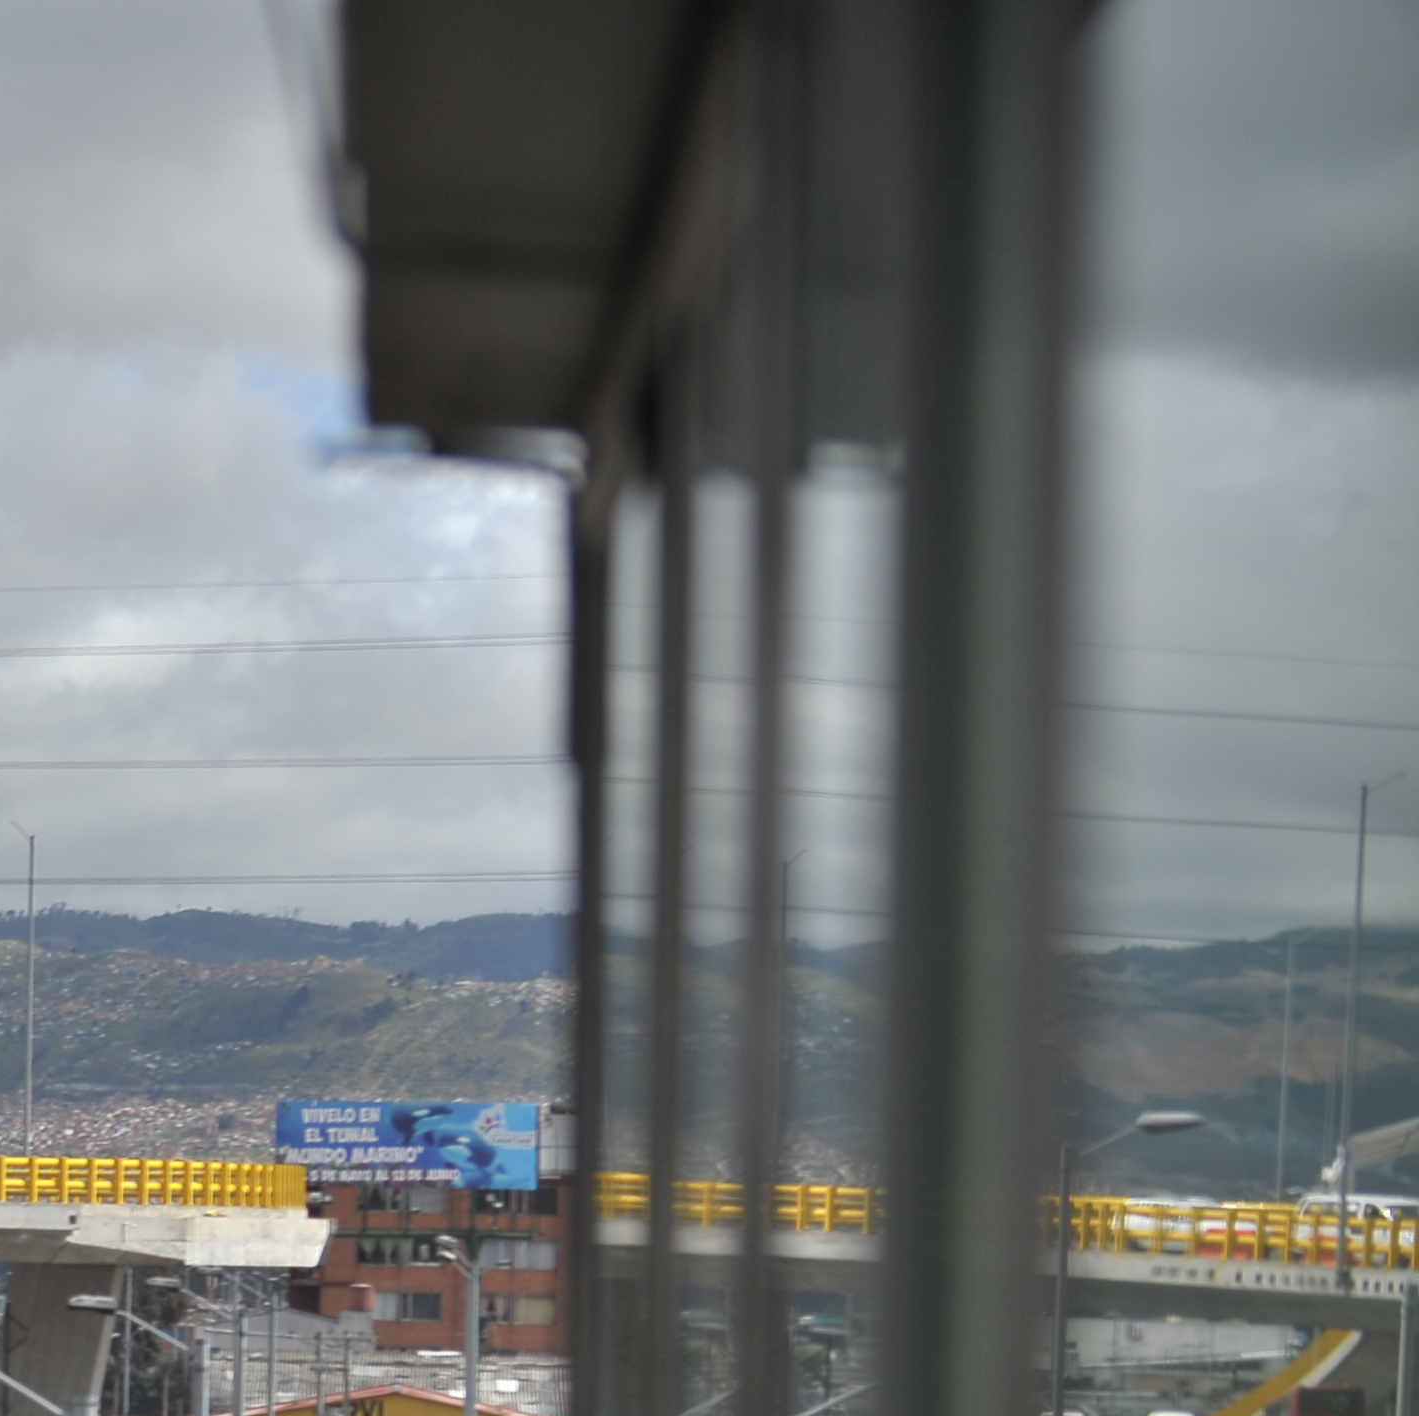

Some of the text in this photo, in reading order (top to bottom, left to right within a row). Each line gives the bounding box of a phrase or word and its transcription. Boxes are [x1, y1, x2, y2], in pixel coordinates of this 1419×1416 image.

[358, 1107, 381, 1123] EN
[304, 1128, 380, 1143] EL TUNAL
